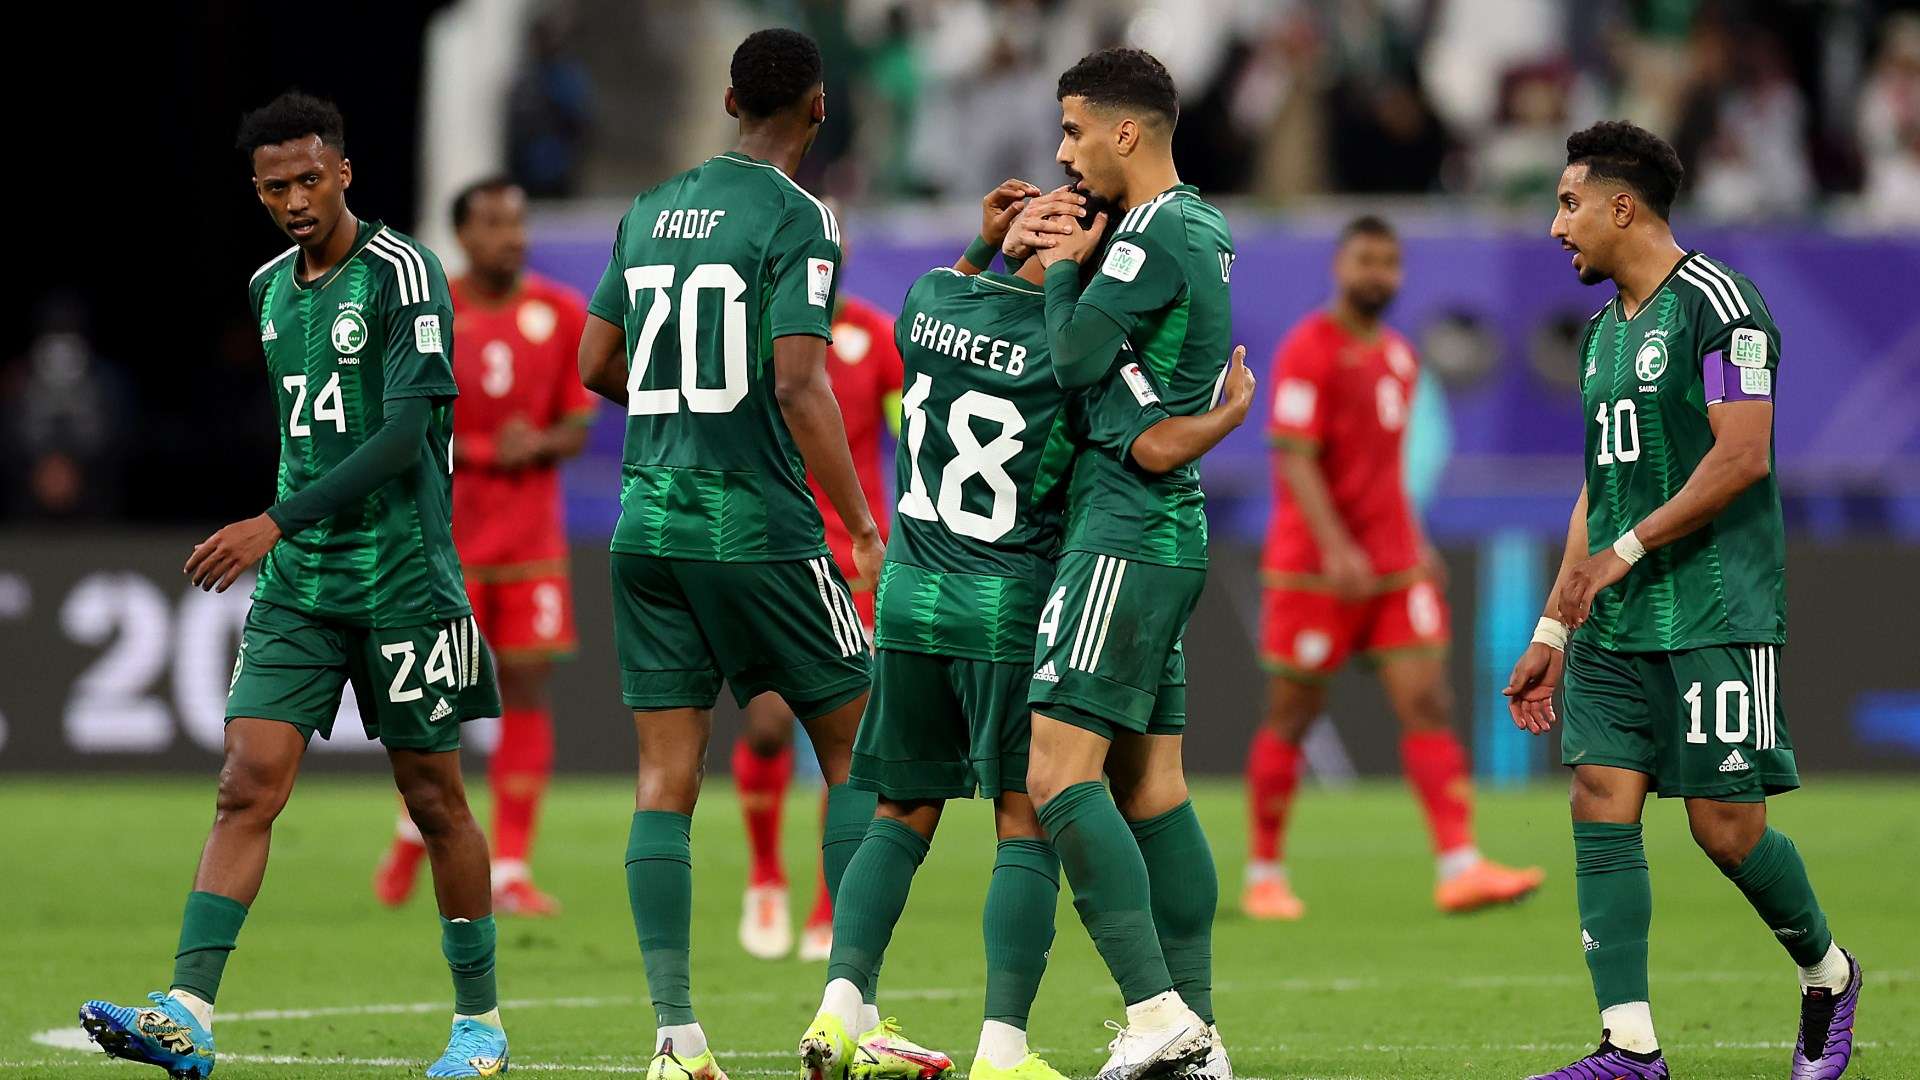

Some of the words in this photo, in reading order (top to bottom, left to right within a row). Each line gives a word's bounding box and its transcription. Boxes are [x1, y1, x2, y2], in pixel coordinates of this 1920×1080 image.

[652, 208, 726, 239] RADIF
[1117, 246, 1131, 255] AFC
[420, 320, 435, 328] AFC
[624, 263, 749, 416] 20
[1738, 333, 1753, 342] AFC
[910, 311, 1027, 377] GHAREEB
[1736, 340, 1762, 353] LIVE
[337, 357, 361, 365] SAUDI
[481, 339, 515, 398] 3
[282, 371, 347, 437] 24
[1638, 385, 1658, 393] SAUDI
[1595, 398, 1641, 466] 10
[897, 372, 1027, 543] 18
[1037, 585, 1067, 647] 4
[381, 629, 456, 703] 24
[1033, 672, 1060, 683] adidas
[429, 706, 453, 722] adidas
[1683, 681, 1750, 744] 10
[1718, 762, 1750, 772] adidas
